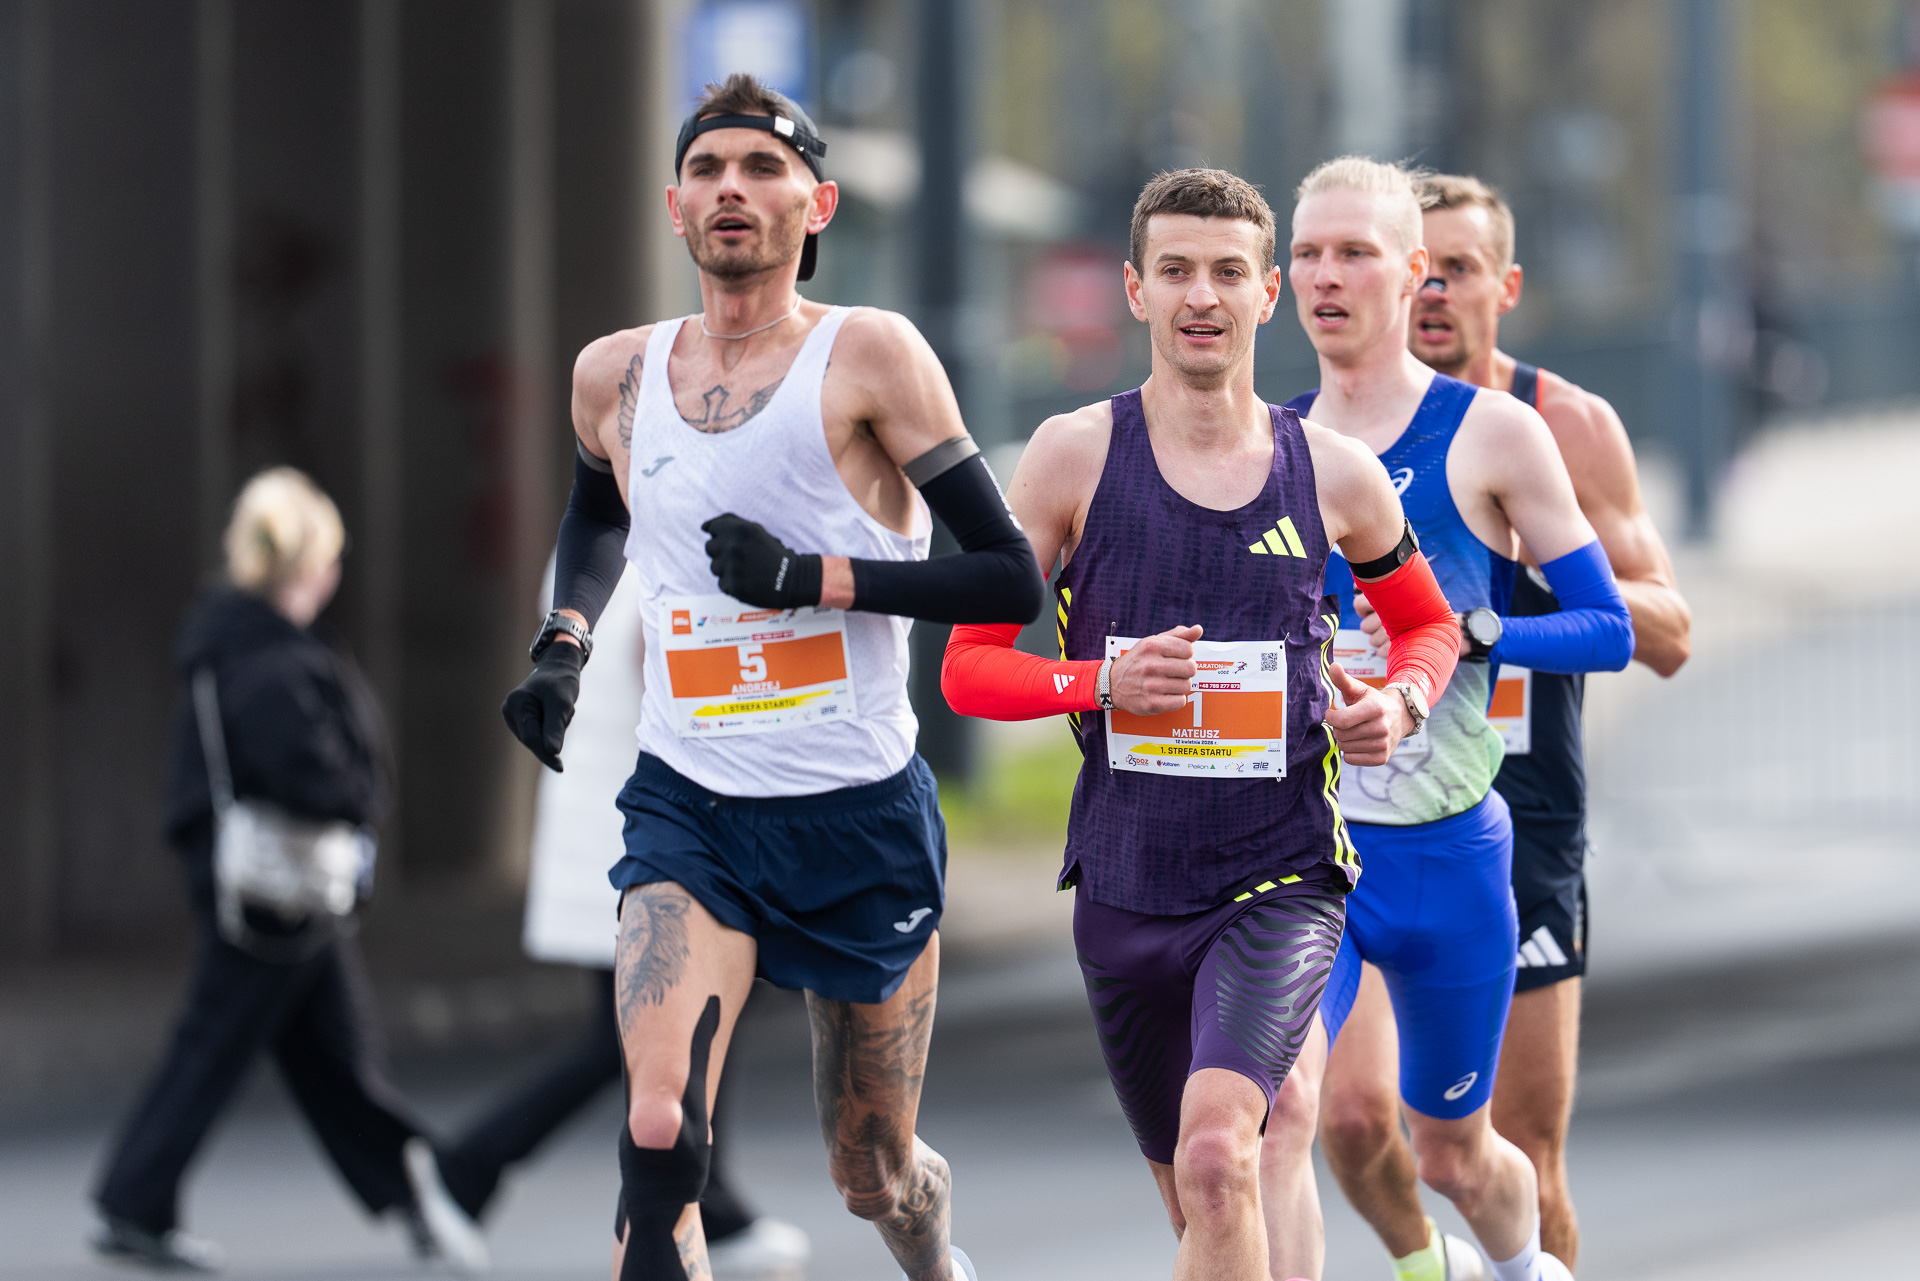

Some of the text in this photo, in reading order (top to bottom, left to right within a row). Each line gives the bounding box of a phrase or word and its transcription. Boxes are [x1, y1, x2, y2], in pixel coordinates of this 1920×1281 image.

[737, 643, 768, 682] 5
[732, 680, 780, 694] ANDRZEJ
[730, 702, 761, 712] STREFA
[764, 699, 796, 709] STARTU
[1187, 692, 1202, 727] 1
[1172, 728, 1220, 739] MATEUSZ
[1168, 747, 1198, 755] STREFA
[1200, 748, 1232, 756] STARTU
